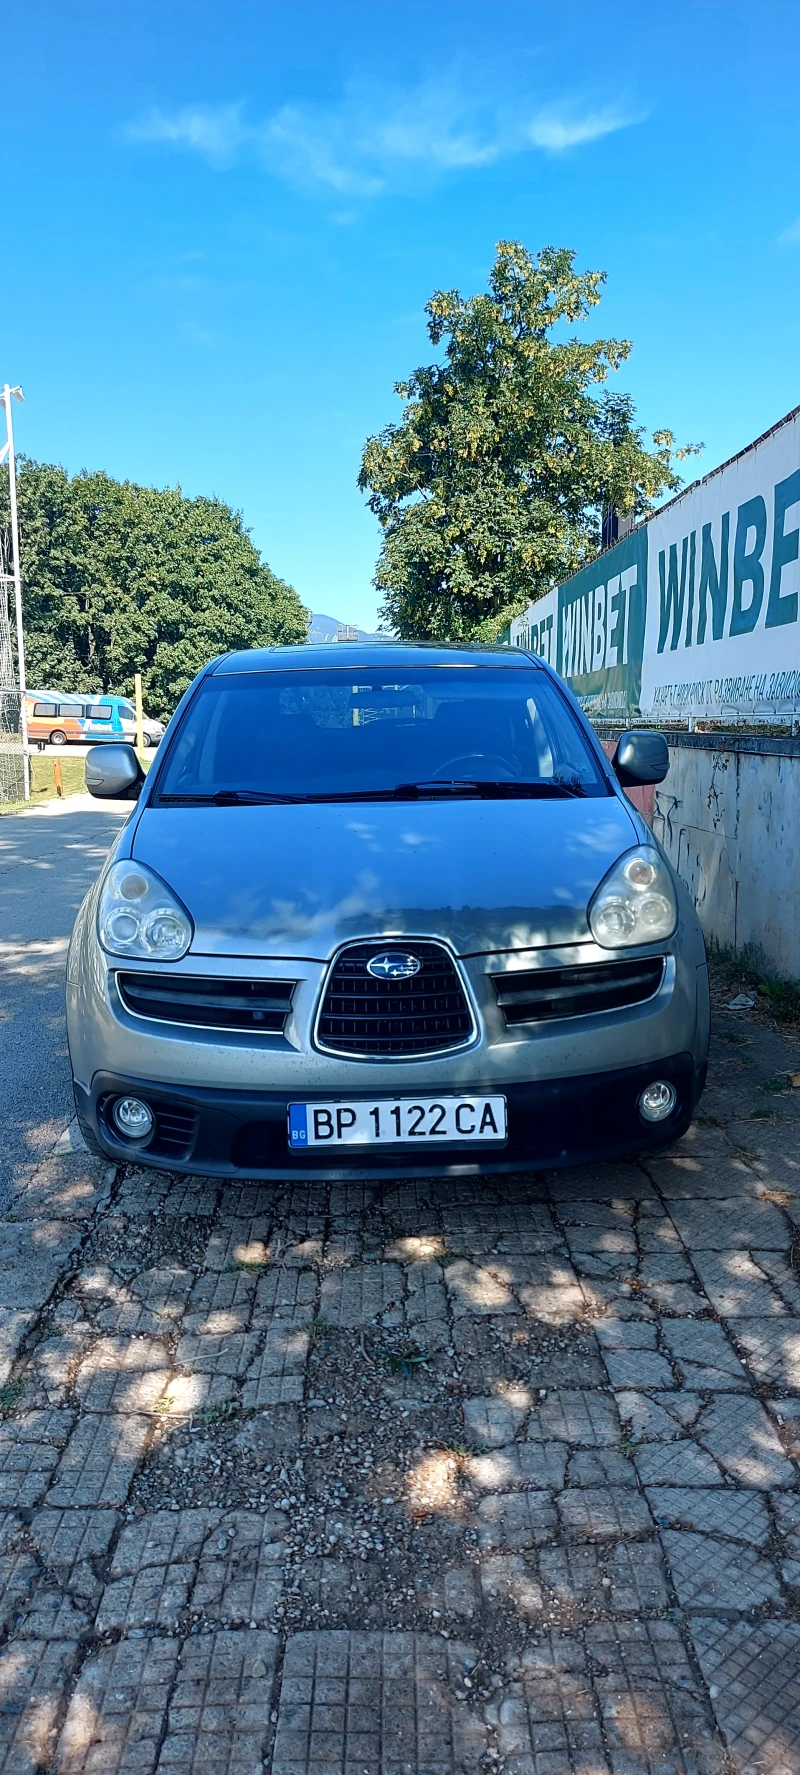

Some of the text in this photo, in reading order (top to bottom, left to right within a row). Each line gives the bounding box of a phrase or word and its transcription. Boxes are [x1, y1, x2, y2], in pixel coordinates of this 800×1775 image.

[562, 564, 638, 678] WINBET
[714, 675, 755, 703] РАЗВИВАНЕ
[754, 674, 767, 701] НА
[292, 1131, 306, 1140] BG
[313, 1102, 498, 1140] BP 1122 CA
